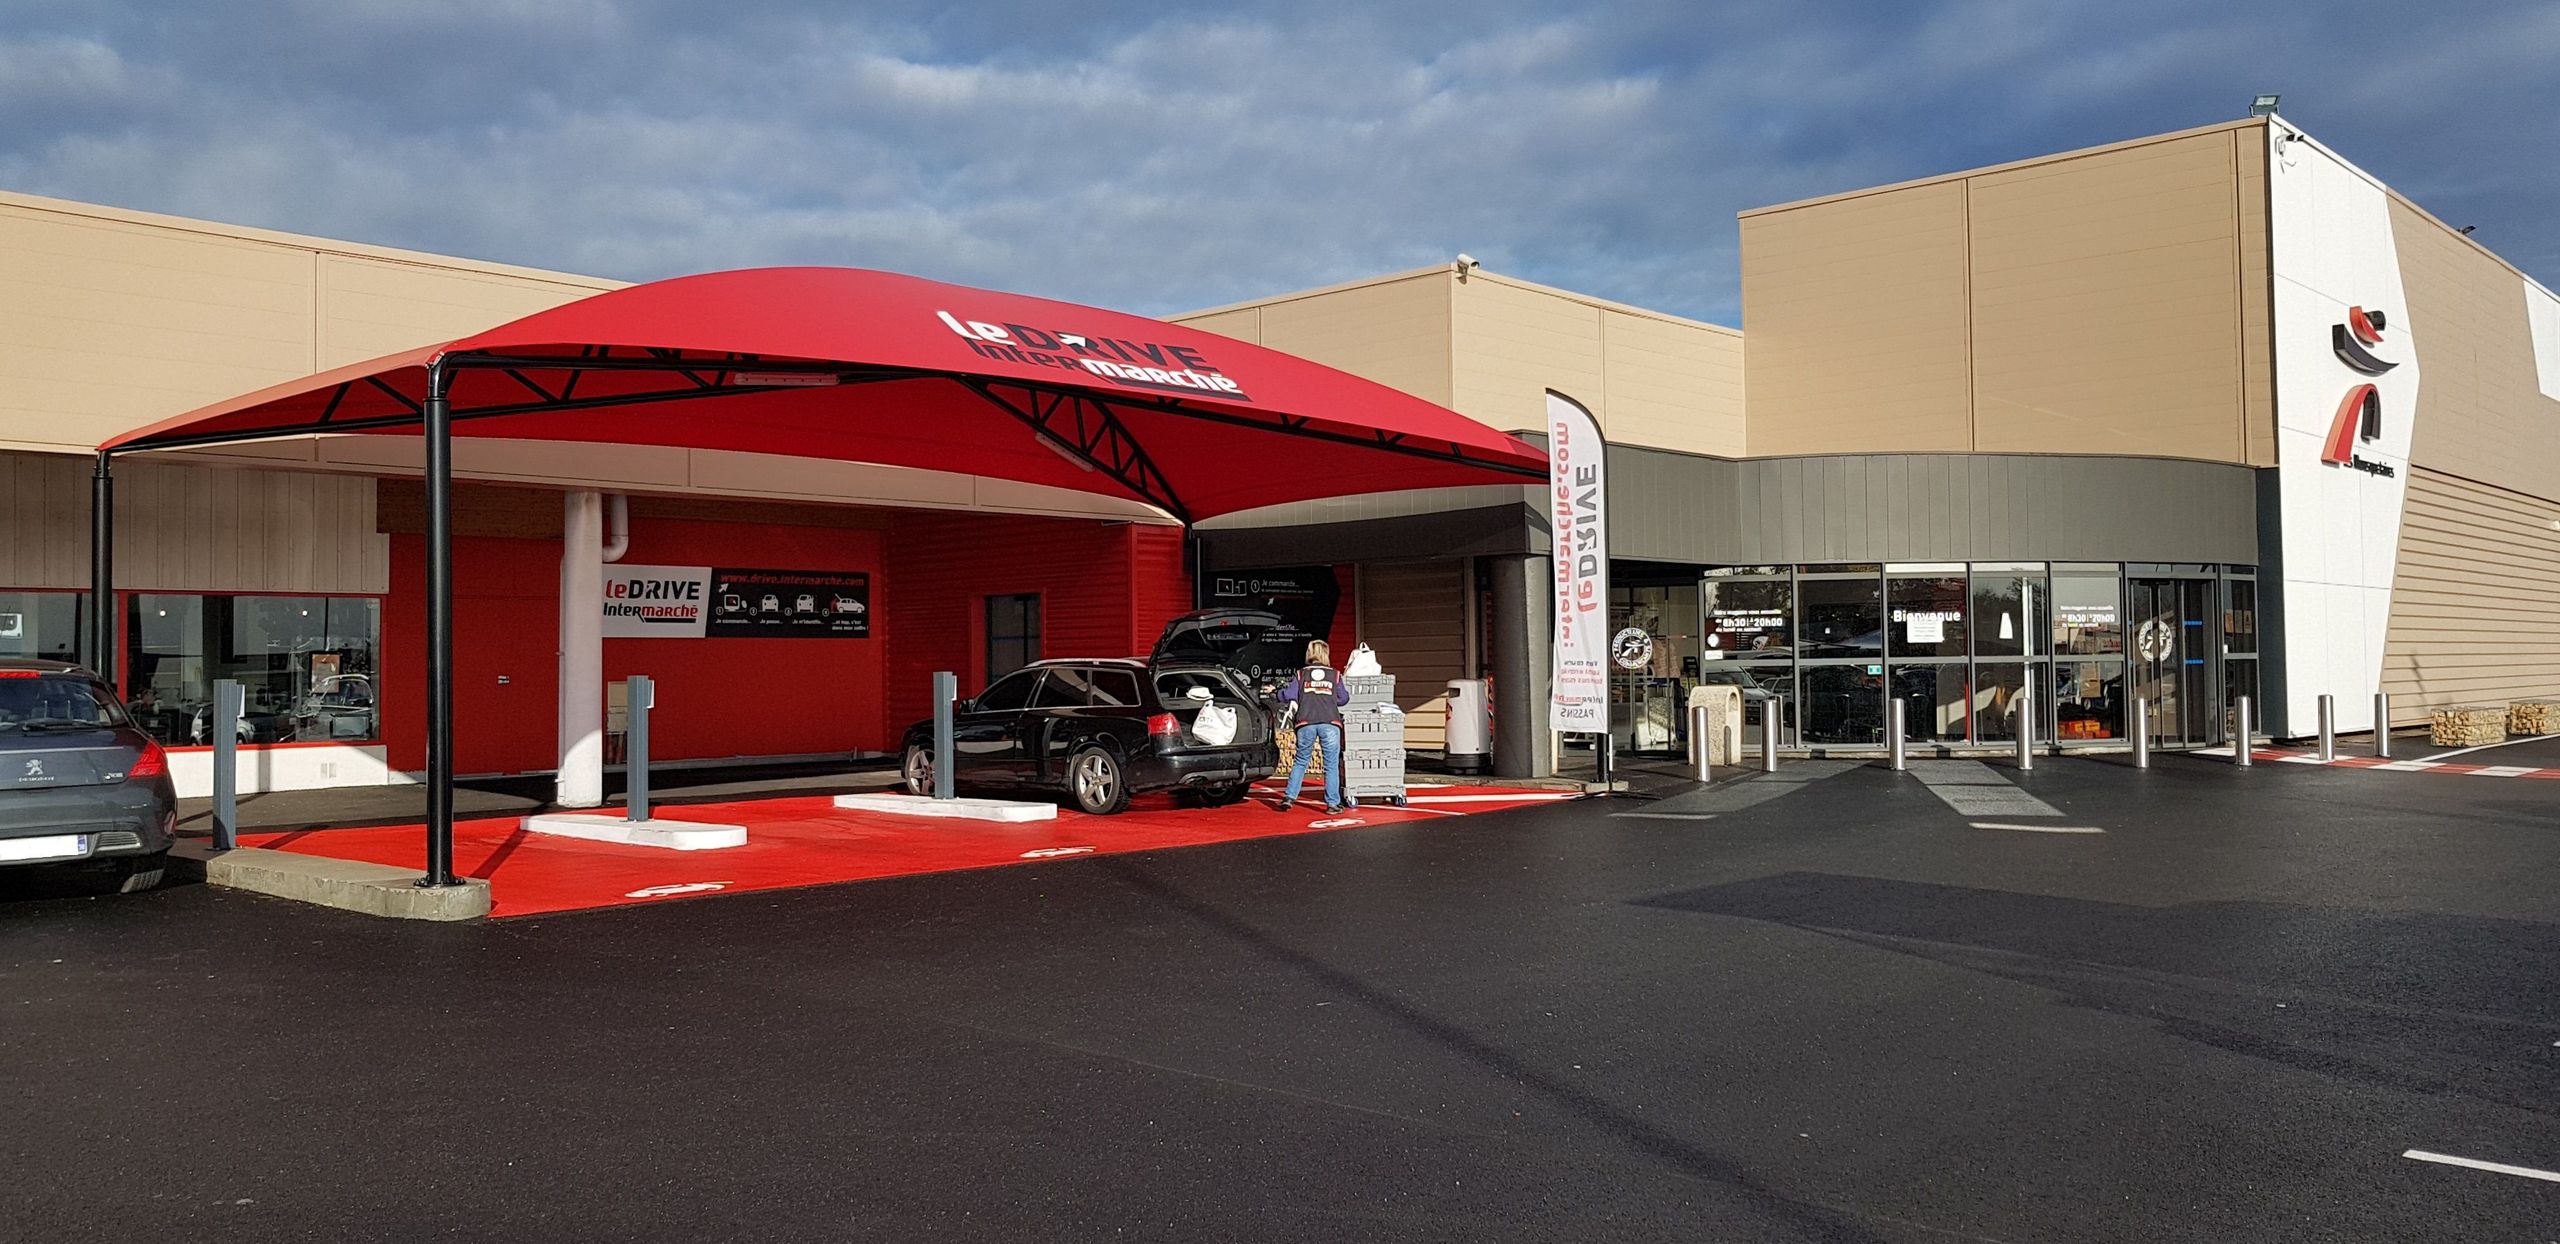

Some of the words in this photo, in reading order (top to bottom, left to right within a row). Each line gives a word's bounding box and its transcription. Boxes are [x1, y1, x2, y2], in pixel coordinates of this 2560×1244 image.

[962, 337, 1245, 394] Intermarché
[606, 579, 701, 600] leDRIVE
[602, 601, 698, 618] Intermarché
[1722, 618, 1746, 627] 8h30
[1754, 617, 1783, 626] 20h00
